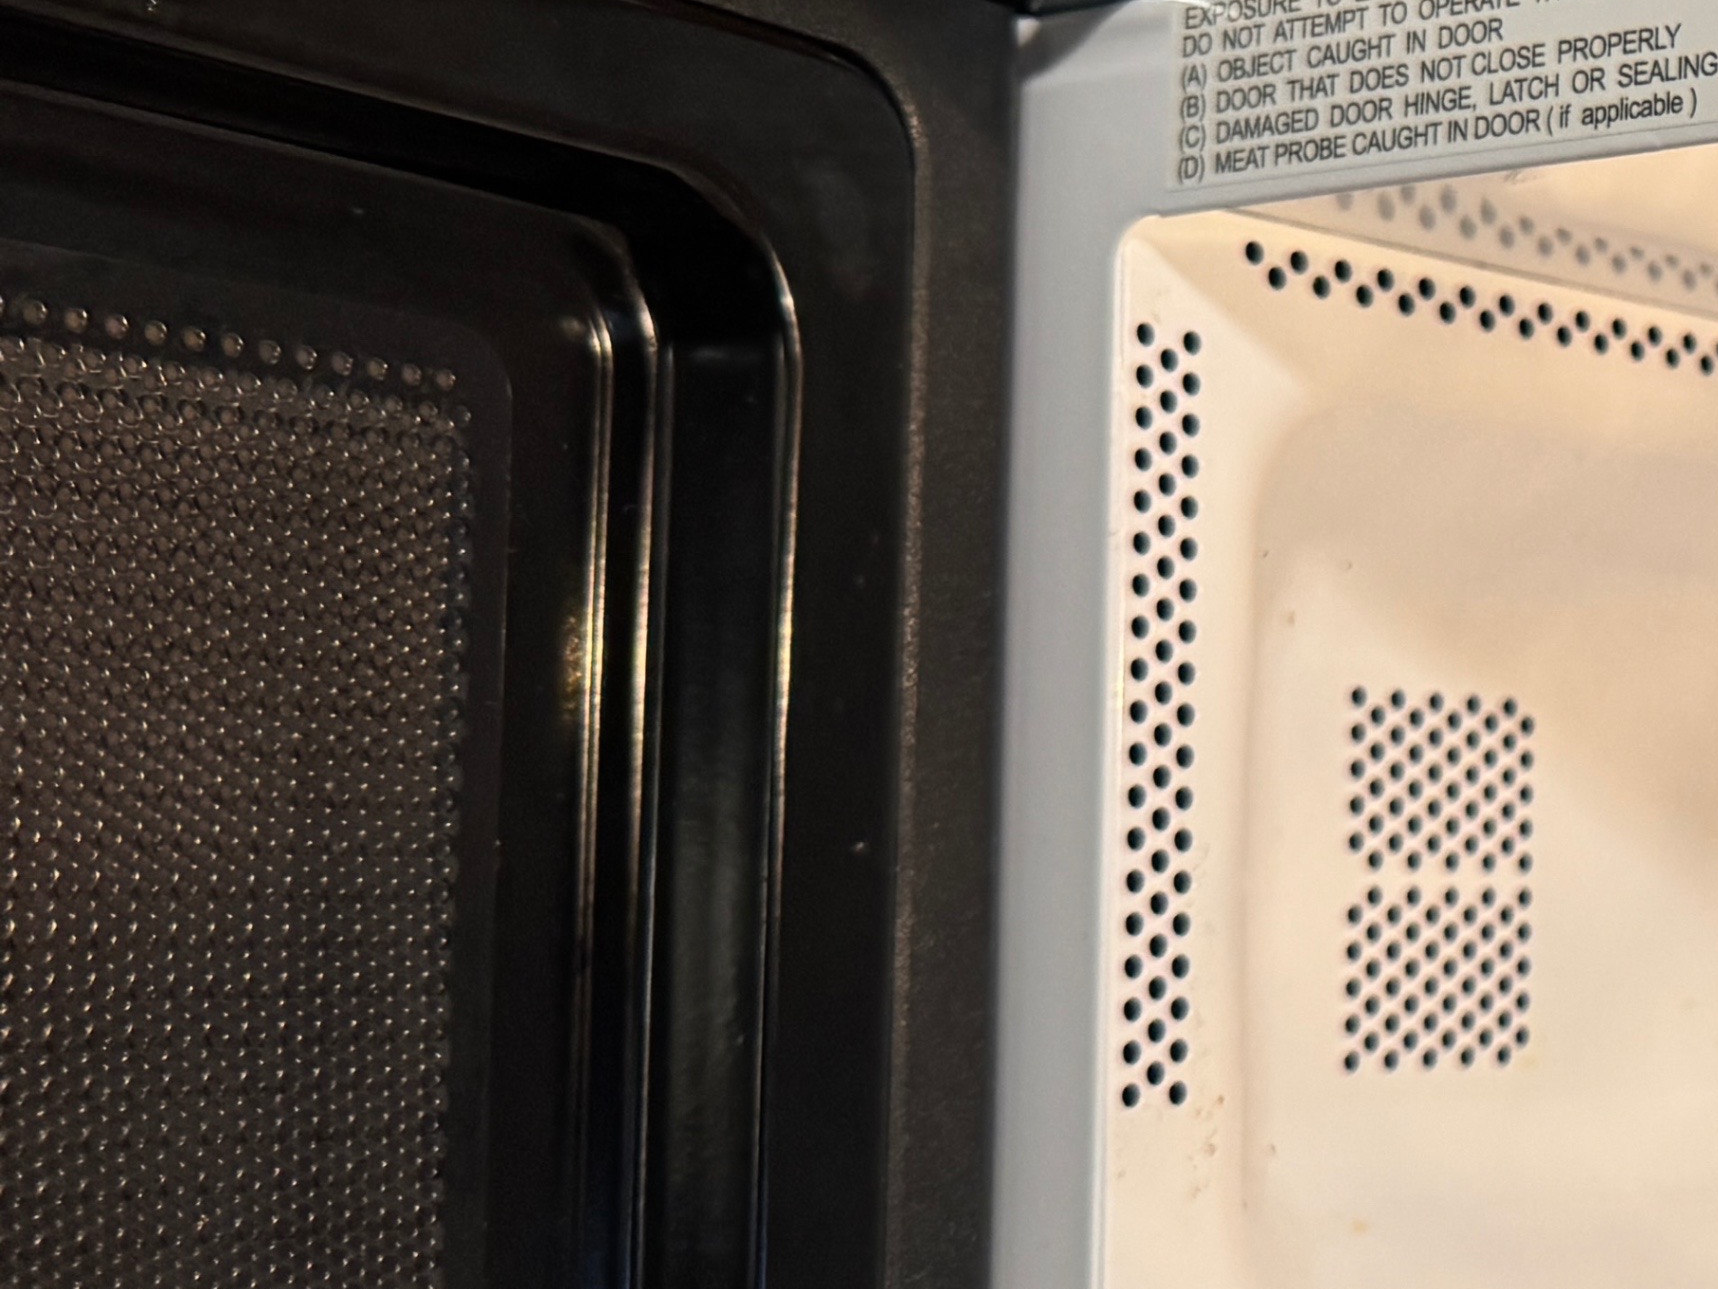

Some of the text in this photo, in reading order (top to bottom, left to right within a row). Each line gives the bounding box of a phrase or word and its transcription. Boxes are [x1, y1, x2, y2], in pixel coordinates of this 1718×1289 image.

[1179, 22, 1682, 125] (B) DOOR THAT DOES NOT CLOSE PROPERLY
[1181, 31, 1213, 59] DO
[1221, 22, 1264, 51] NOT
[1263, 5, 1370, 44] ATTEMPT
[1377, 0, 1408, 27] TO
[1177, 124, 1207, 154] (C)
[1214, 106, 1320, 145] DAMAGED
[1329, 96, 1393, 129] DOOR
[1403, 85, 1477, 118] HINGE,
[1488, 72, 1560, 107] LATCH
[1571, 66, 1606, 95] OR
[1616, 50, 1718, 89] SEALING
